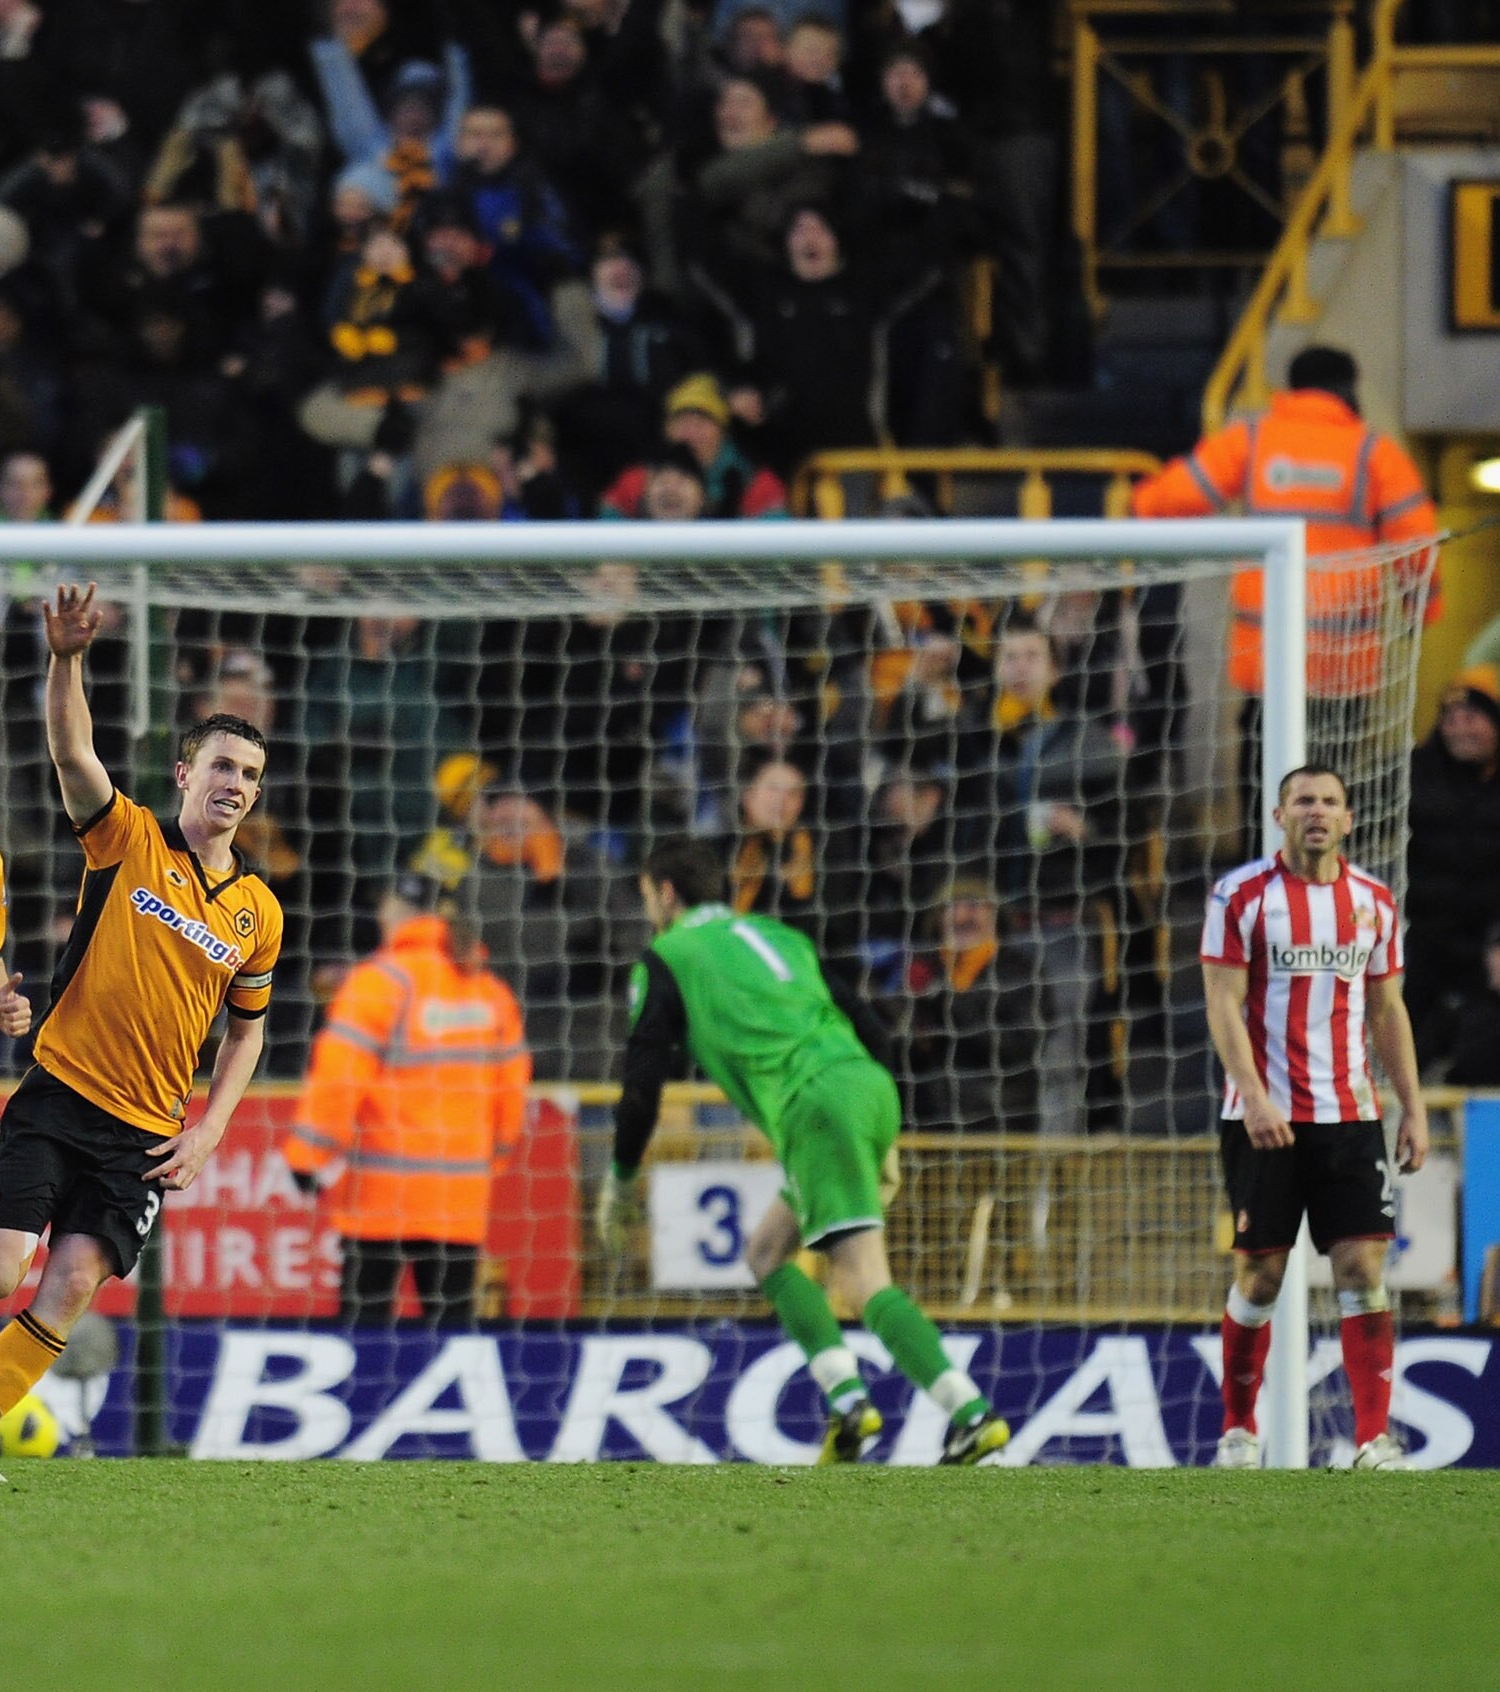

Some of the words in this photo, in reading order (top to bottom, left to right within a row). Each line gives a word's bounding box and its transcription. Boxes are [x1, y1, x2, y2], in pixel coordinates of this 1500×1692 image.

[733, 920, 792, 981] 1
[135, 1190, 161, 1236] 3
[697, 1185, 743, 1268] 3
